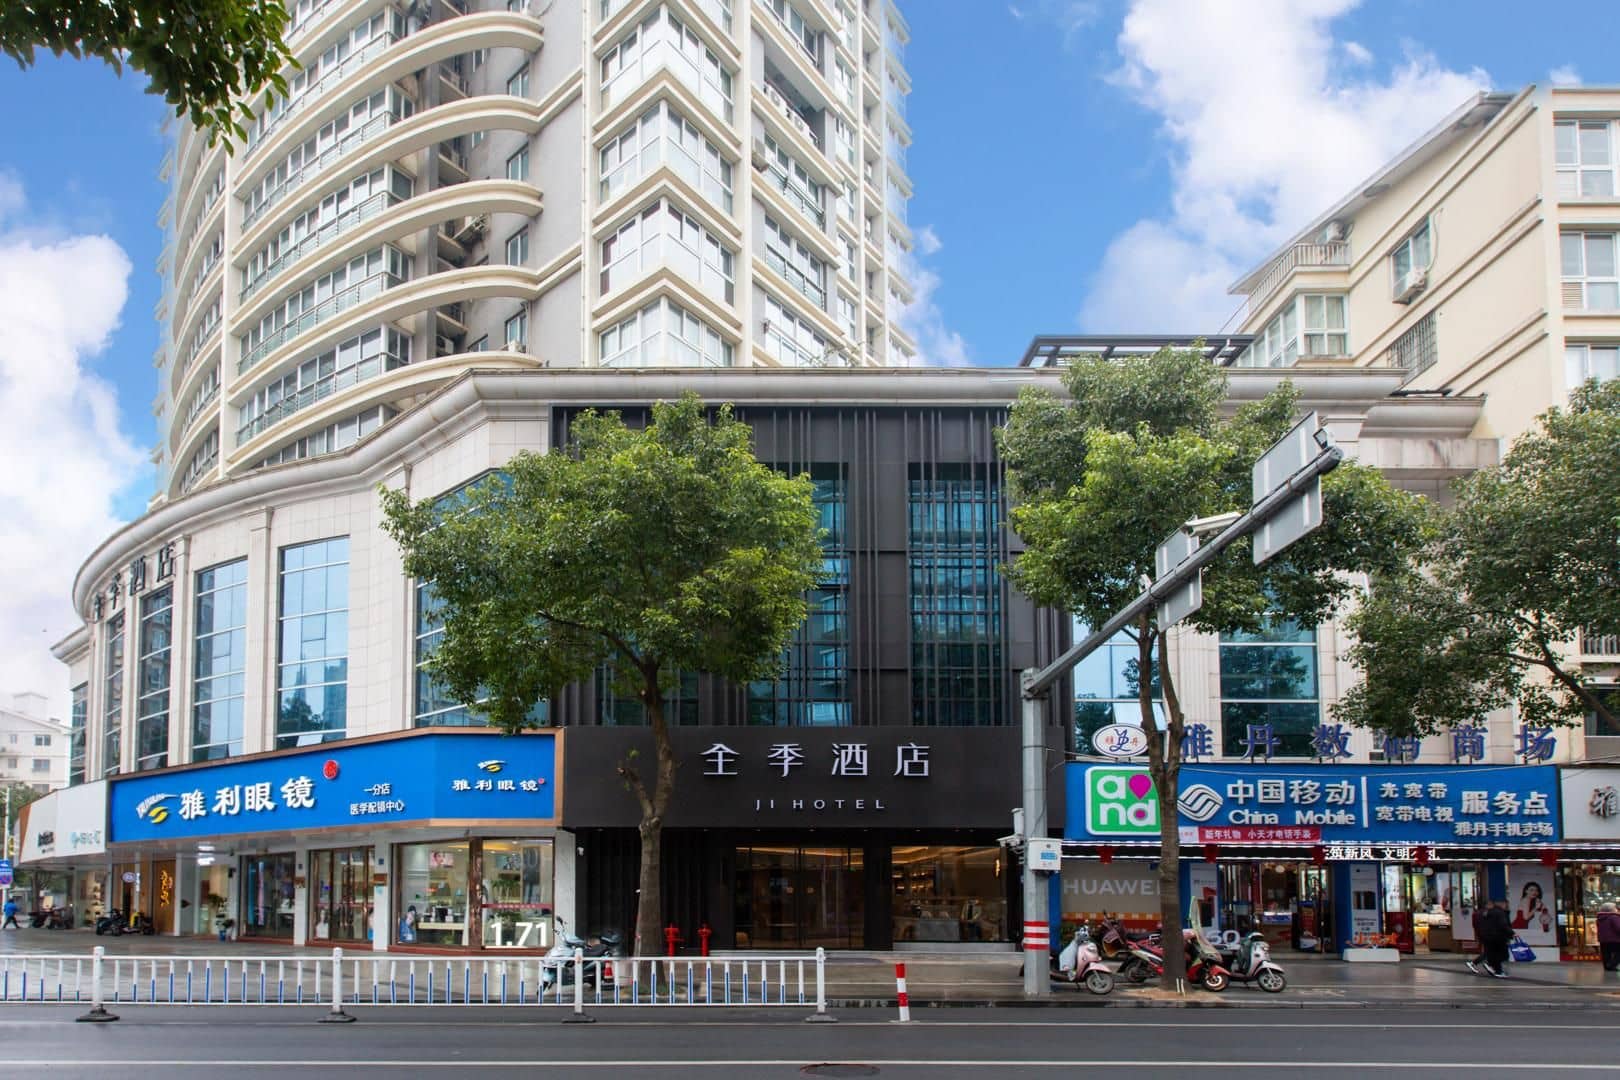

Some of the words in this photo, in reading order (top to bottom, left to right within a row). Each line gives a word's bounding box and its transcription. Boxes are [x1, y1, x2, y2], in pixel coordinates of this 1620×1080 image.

[699, 742, 931, 777] 全季酒店
[363, 783, 391, 797] 一分店
[451, 778, 540, 792] 雅利眼镜
[1226, 778, 1356, 805] 中国移动
[1379, 782, 1448, 798] 光宽带
[178, 775, 316, 820] 雅利眼镜
[755, 799, 775, 812] JI
[792, 799, 886, 810] HOTEL
[1460, 790, 1550, 815] 服务点
[1228, 808, 1280, 825] China
[1295, 808, 1356, 825] Mobile
[1375, 805, 1455, 822] 宽带电视
[1454, 822, 1554, 837] 雅丹手机卖场
[1063, 879, 1161, 896] HUAWEI
[491, 921, 547, 946] 1.71
